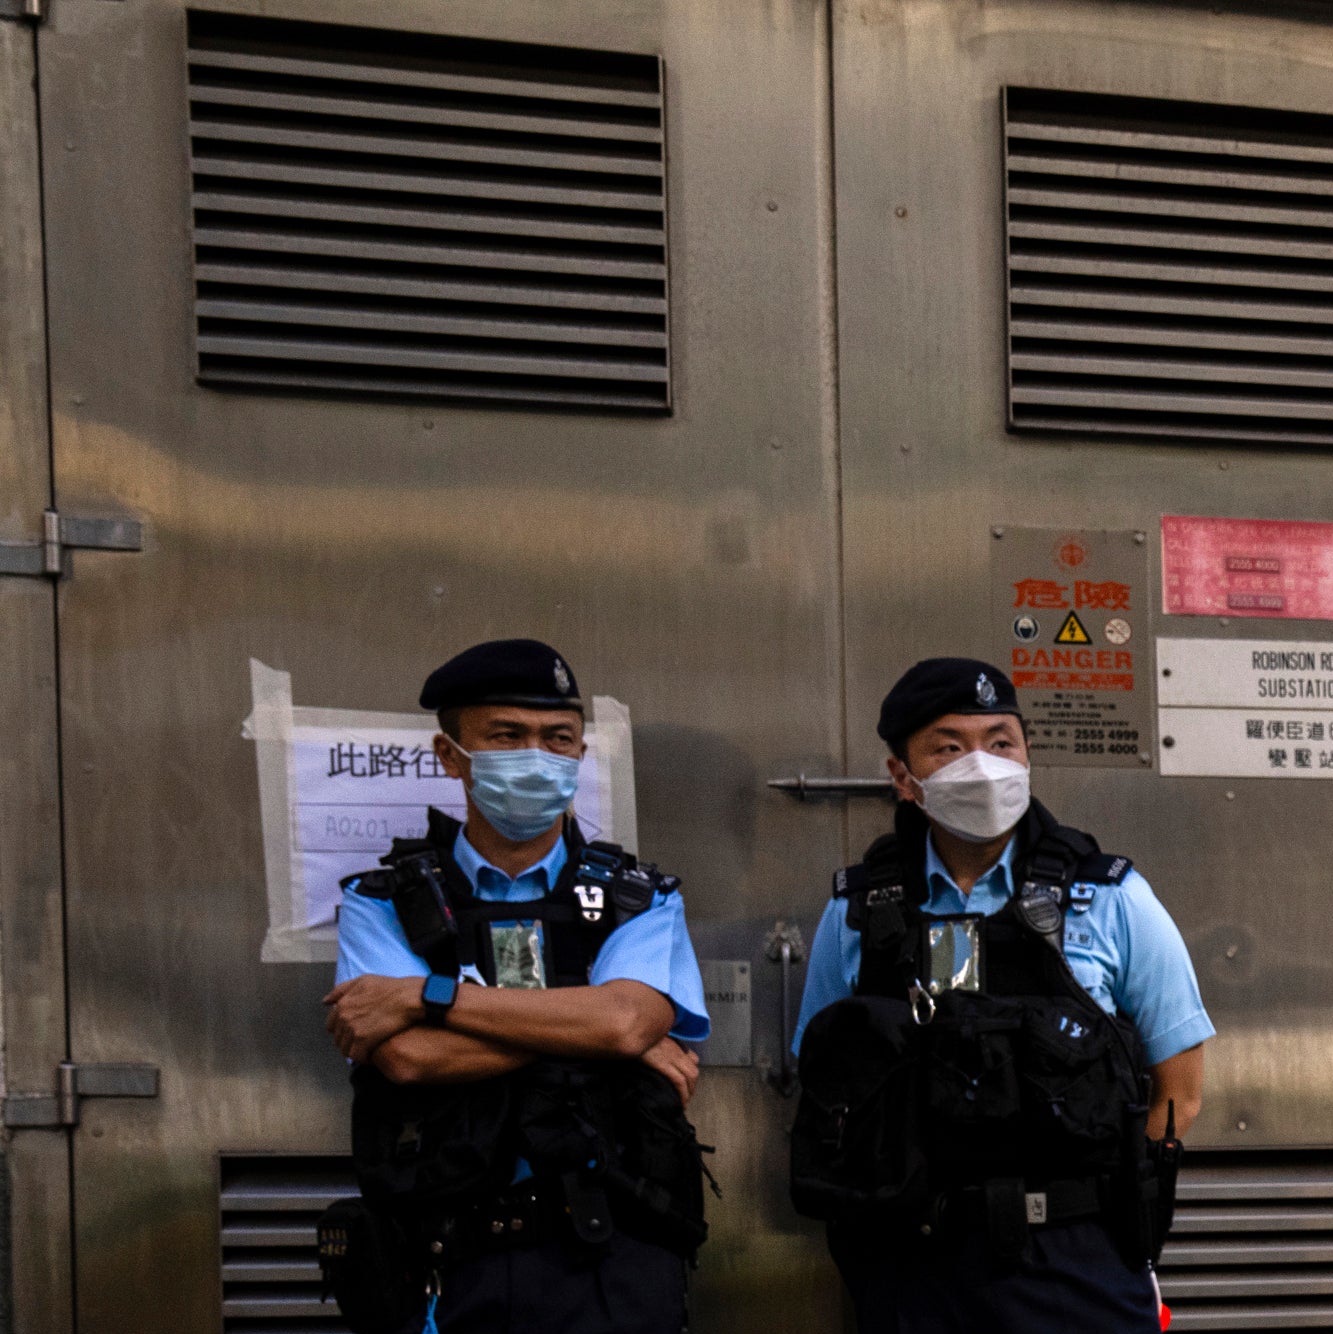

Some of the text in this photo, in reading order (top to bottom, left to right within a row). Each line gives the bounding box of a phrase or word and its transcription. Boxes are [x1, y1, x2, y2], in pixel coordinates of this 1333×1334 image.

[1013, 579, 1132, 611] 危險
[1012, 648, 1133, 670] DANGER
[1252, 651, 1315, 671] ROBINSON
[1074, 728, 1105, 740] 2555
[1108, 730, 1139, 741] 4999
[1074, 743, 1105, 755] 2555
[1108, 743, 1139, 755] 4000
